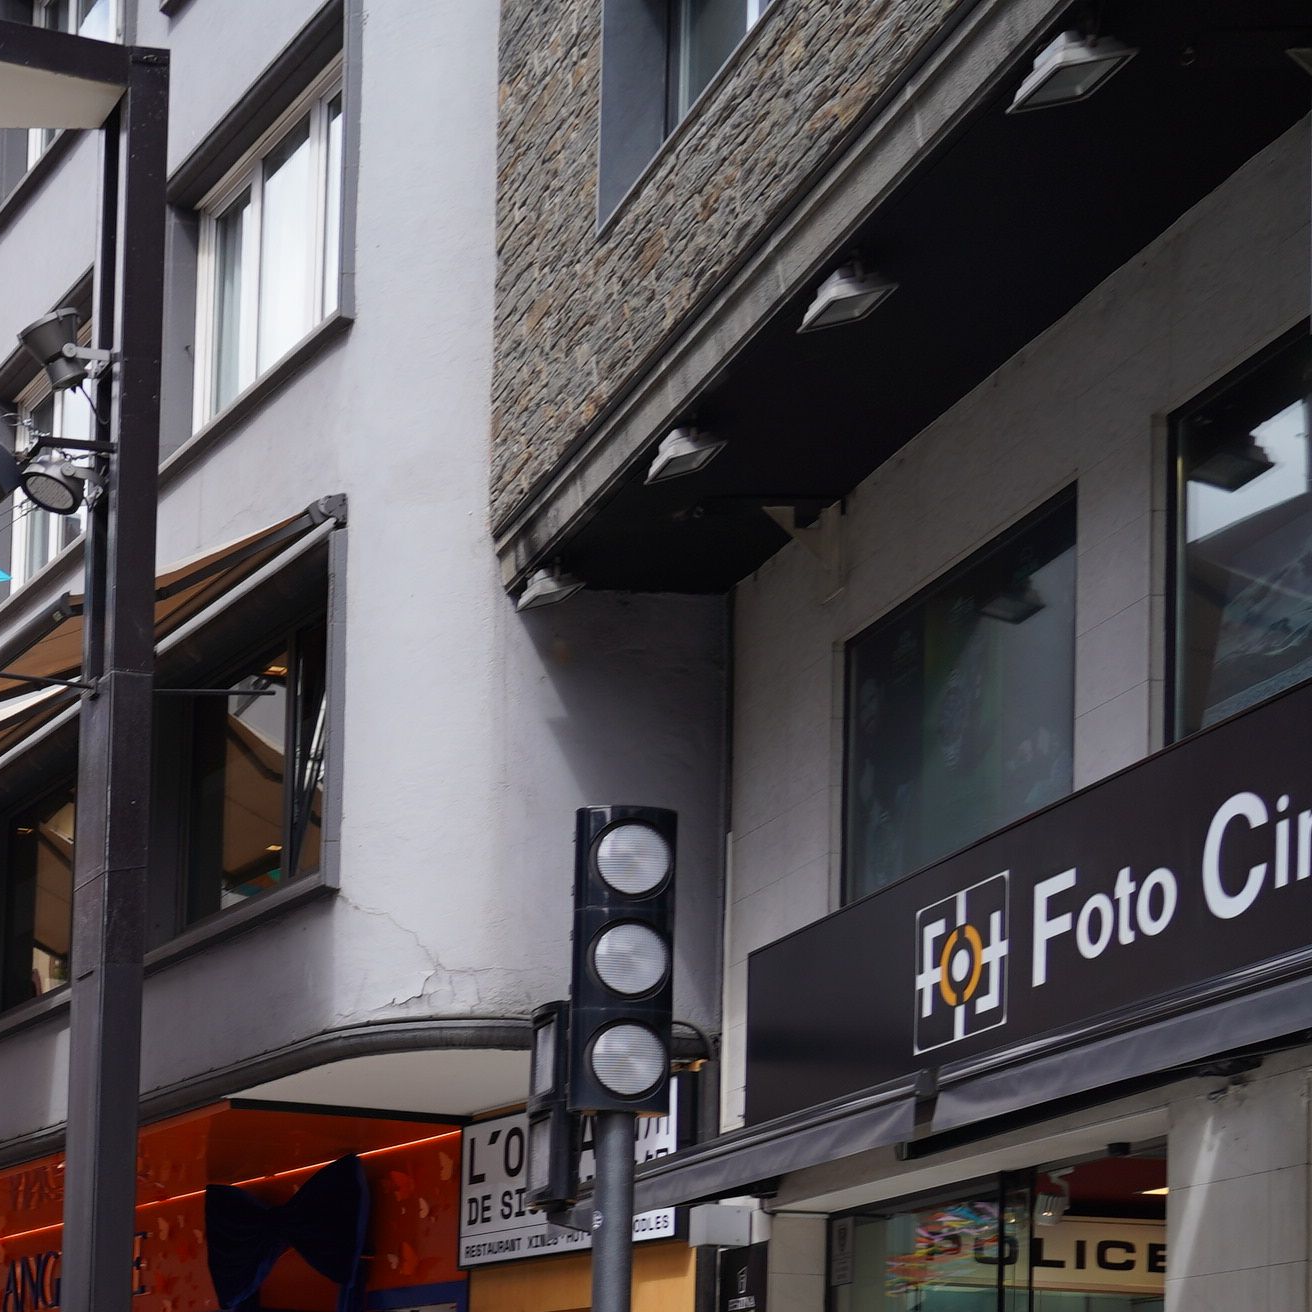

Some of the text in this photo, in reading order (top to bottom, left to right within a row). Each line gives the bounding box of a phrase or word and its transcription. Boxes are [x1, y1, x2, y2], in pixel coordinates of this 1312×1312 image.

[1031, 865, 1178, 988] Foto
[467, 1194, 492, 1227] DE
[464, 1237, 522, 1260] RESTAURANT
[633, 1213, 671, 1235] ODLES
